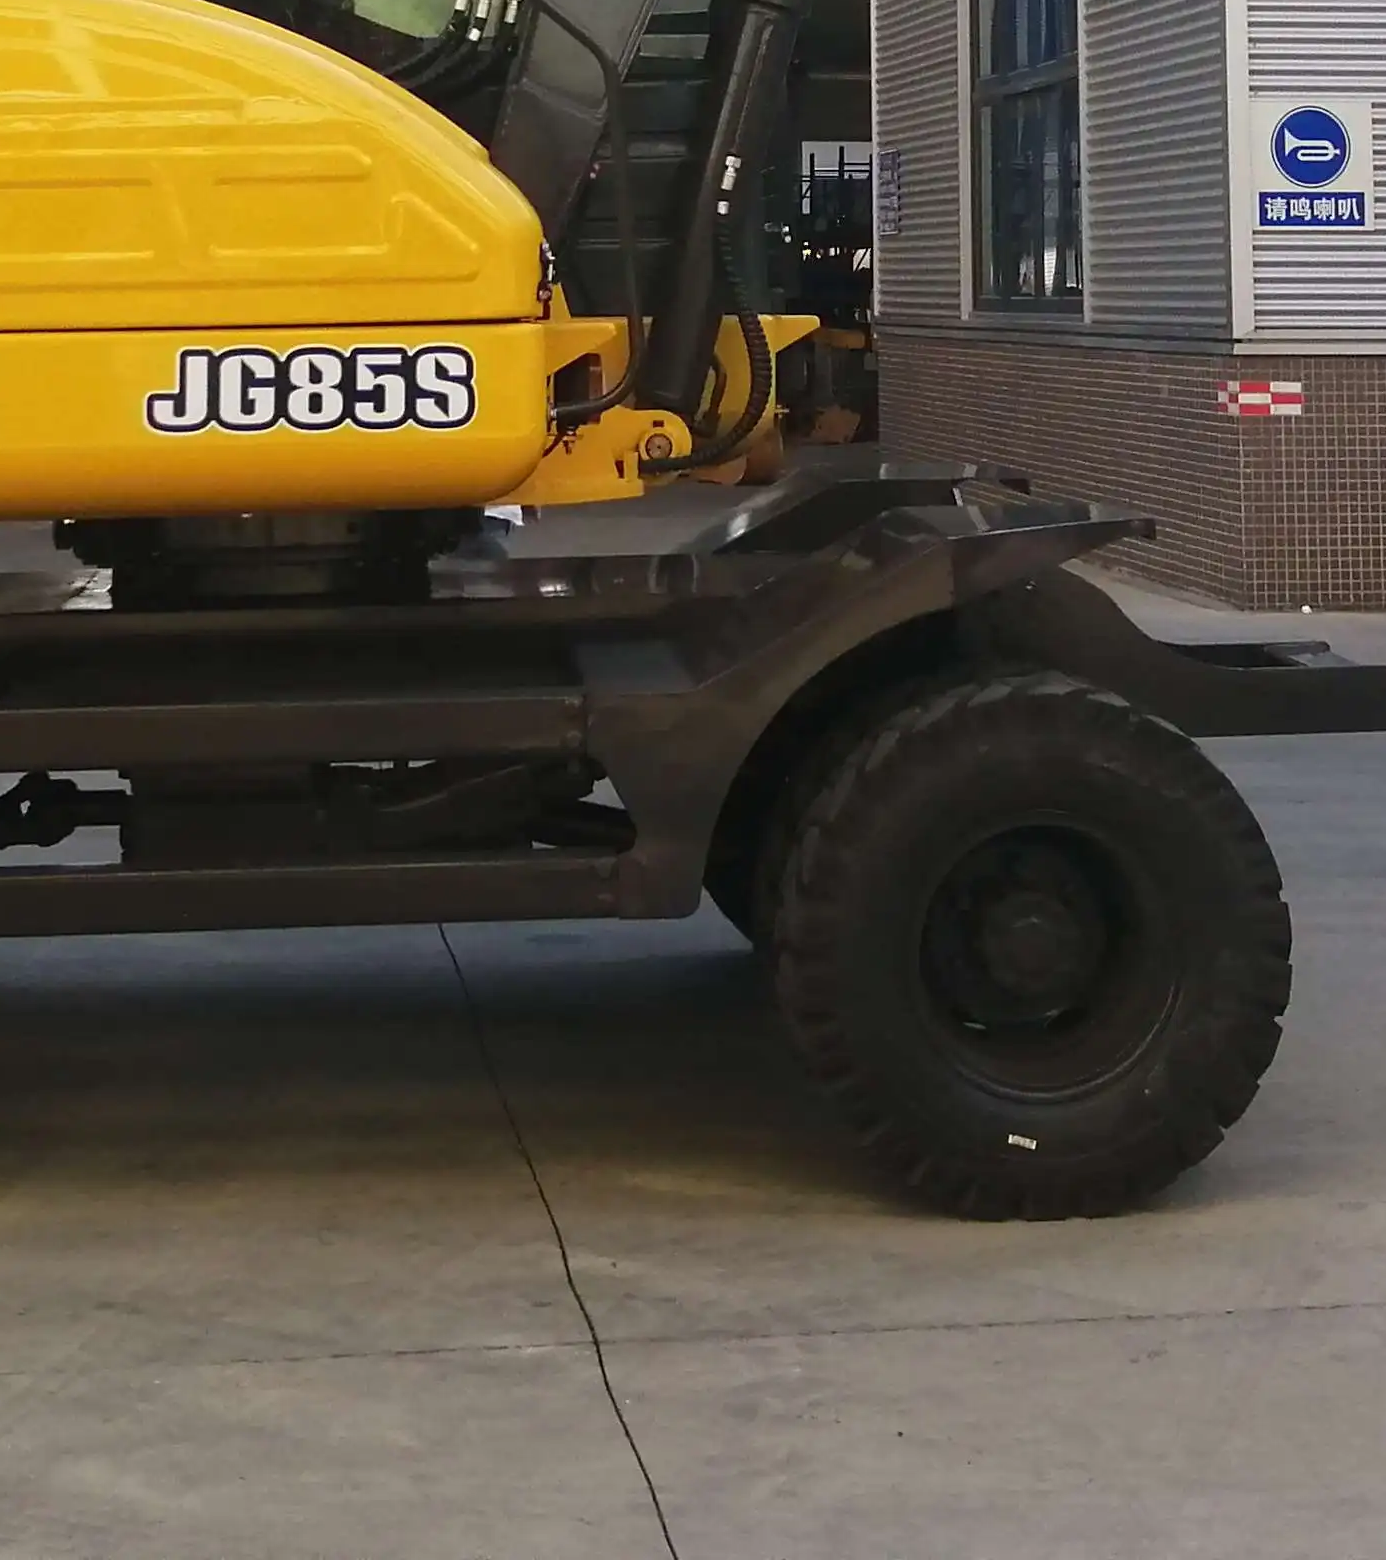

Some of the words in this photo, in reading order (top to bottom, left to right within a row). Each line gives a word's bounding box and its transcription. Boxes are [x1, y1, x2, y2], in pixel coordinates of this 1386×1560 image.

[1264, 196, 1361, 221] 请鸣喇叭
[153, 352, 469, 425] JG85S
